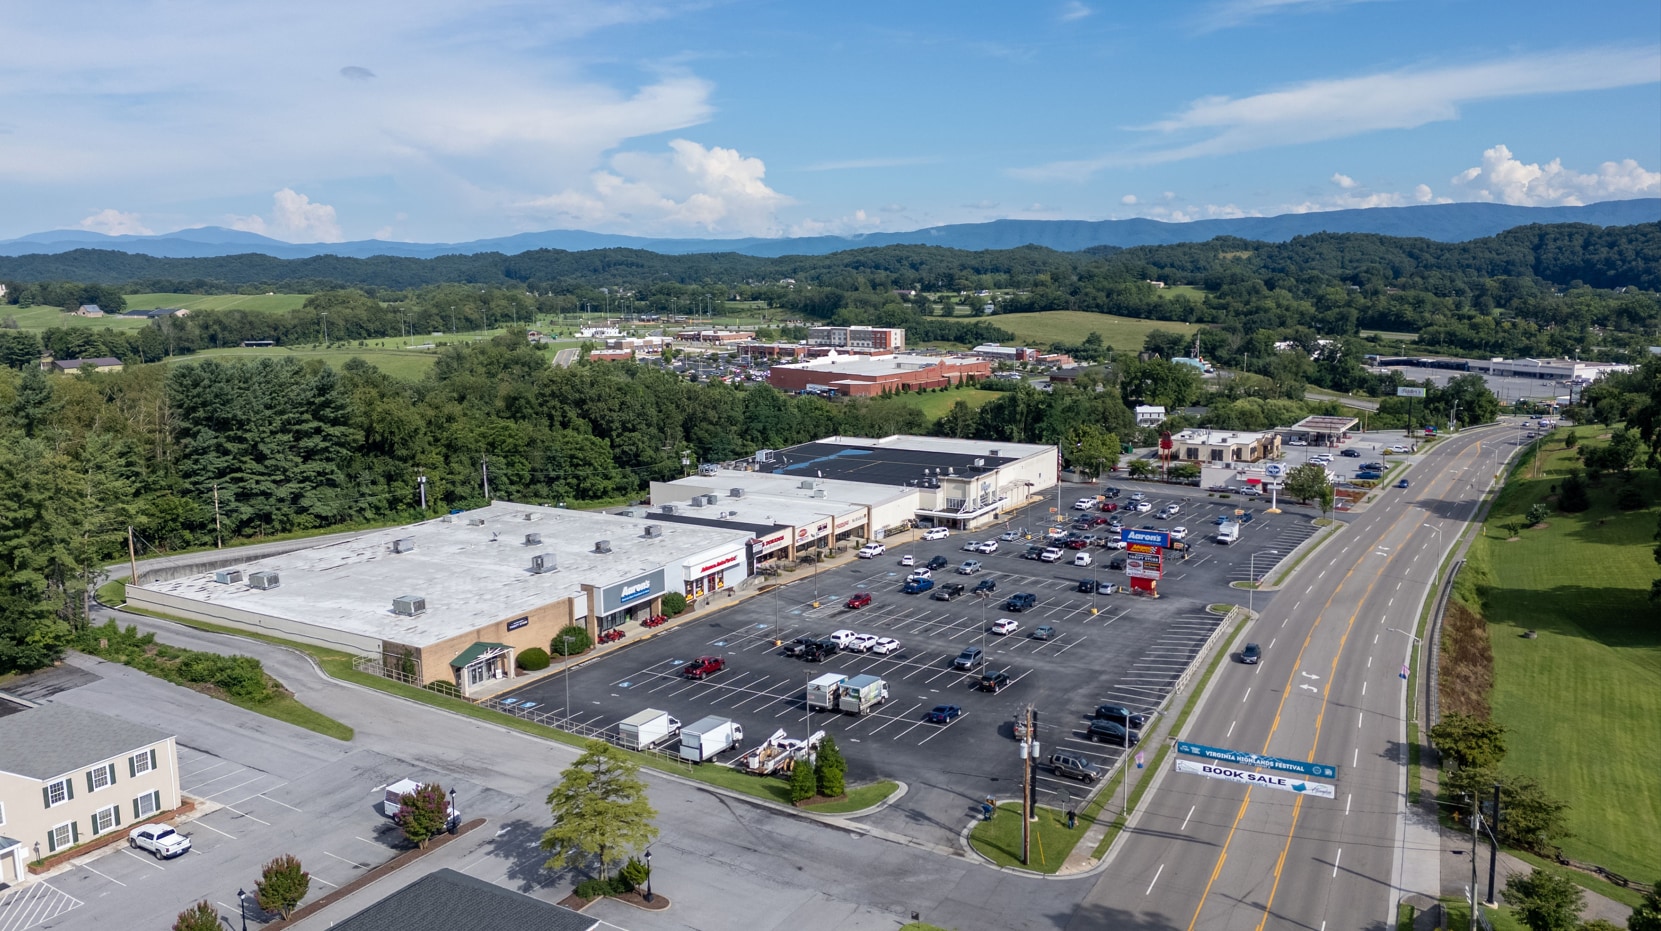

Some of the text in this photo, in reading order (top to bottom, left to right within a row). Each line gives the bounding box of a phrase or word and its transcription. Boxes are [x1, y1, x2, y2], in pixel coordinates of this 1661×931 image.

[1127, 531, 1162, 542] Aaron's
[621, 580, 650, 597] Aaron's
[1205, 750, 1236, 761] VIRGINIA
[1236, 756, 1274, 767] HIGHLANDS
[1275, 762, 1305, 772] FESTIVAL
[1202, 765, 1287, 786] BOOK SALE
